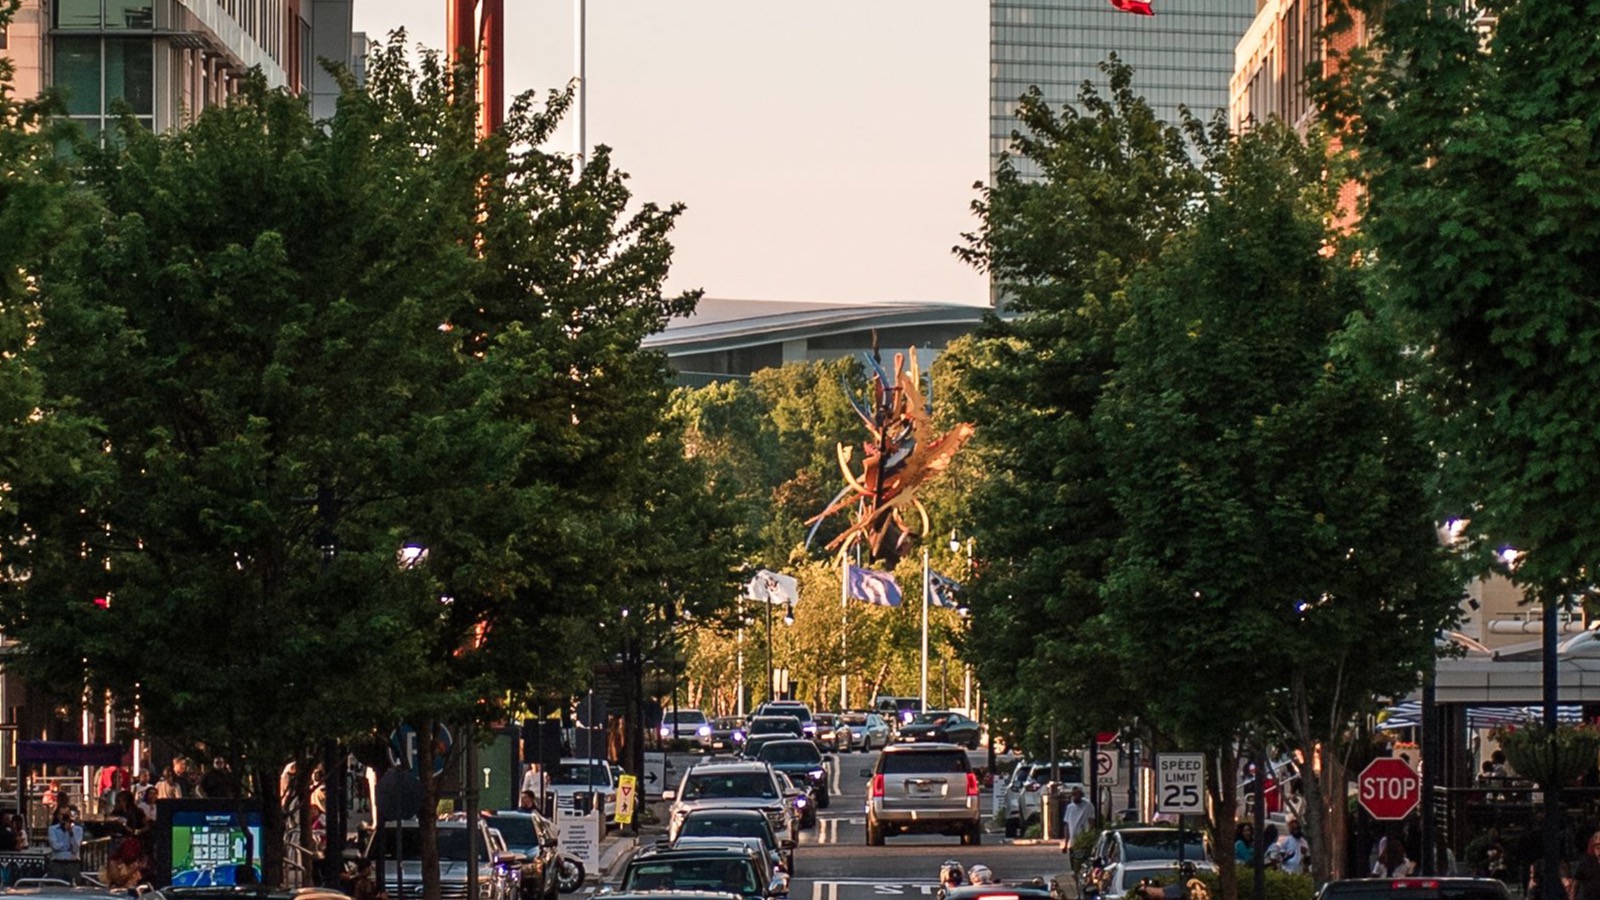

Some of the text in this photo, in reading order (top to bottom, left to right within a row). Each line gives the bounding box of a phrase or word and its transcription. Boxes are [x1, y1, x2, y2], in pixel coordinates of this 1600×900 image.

[1161, 761, 1201, 770] SPEED
[1165, 773, 1196, 782] LIMIT
[1363, 777, 1416, 799] STOP
[1163, 785, 1199, 807] 25
